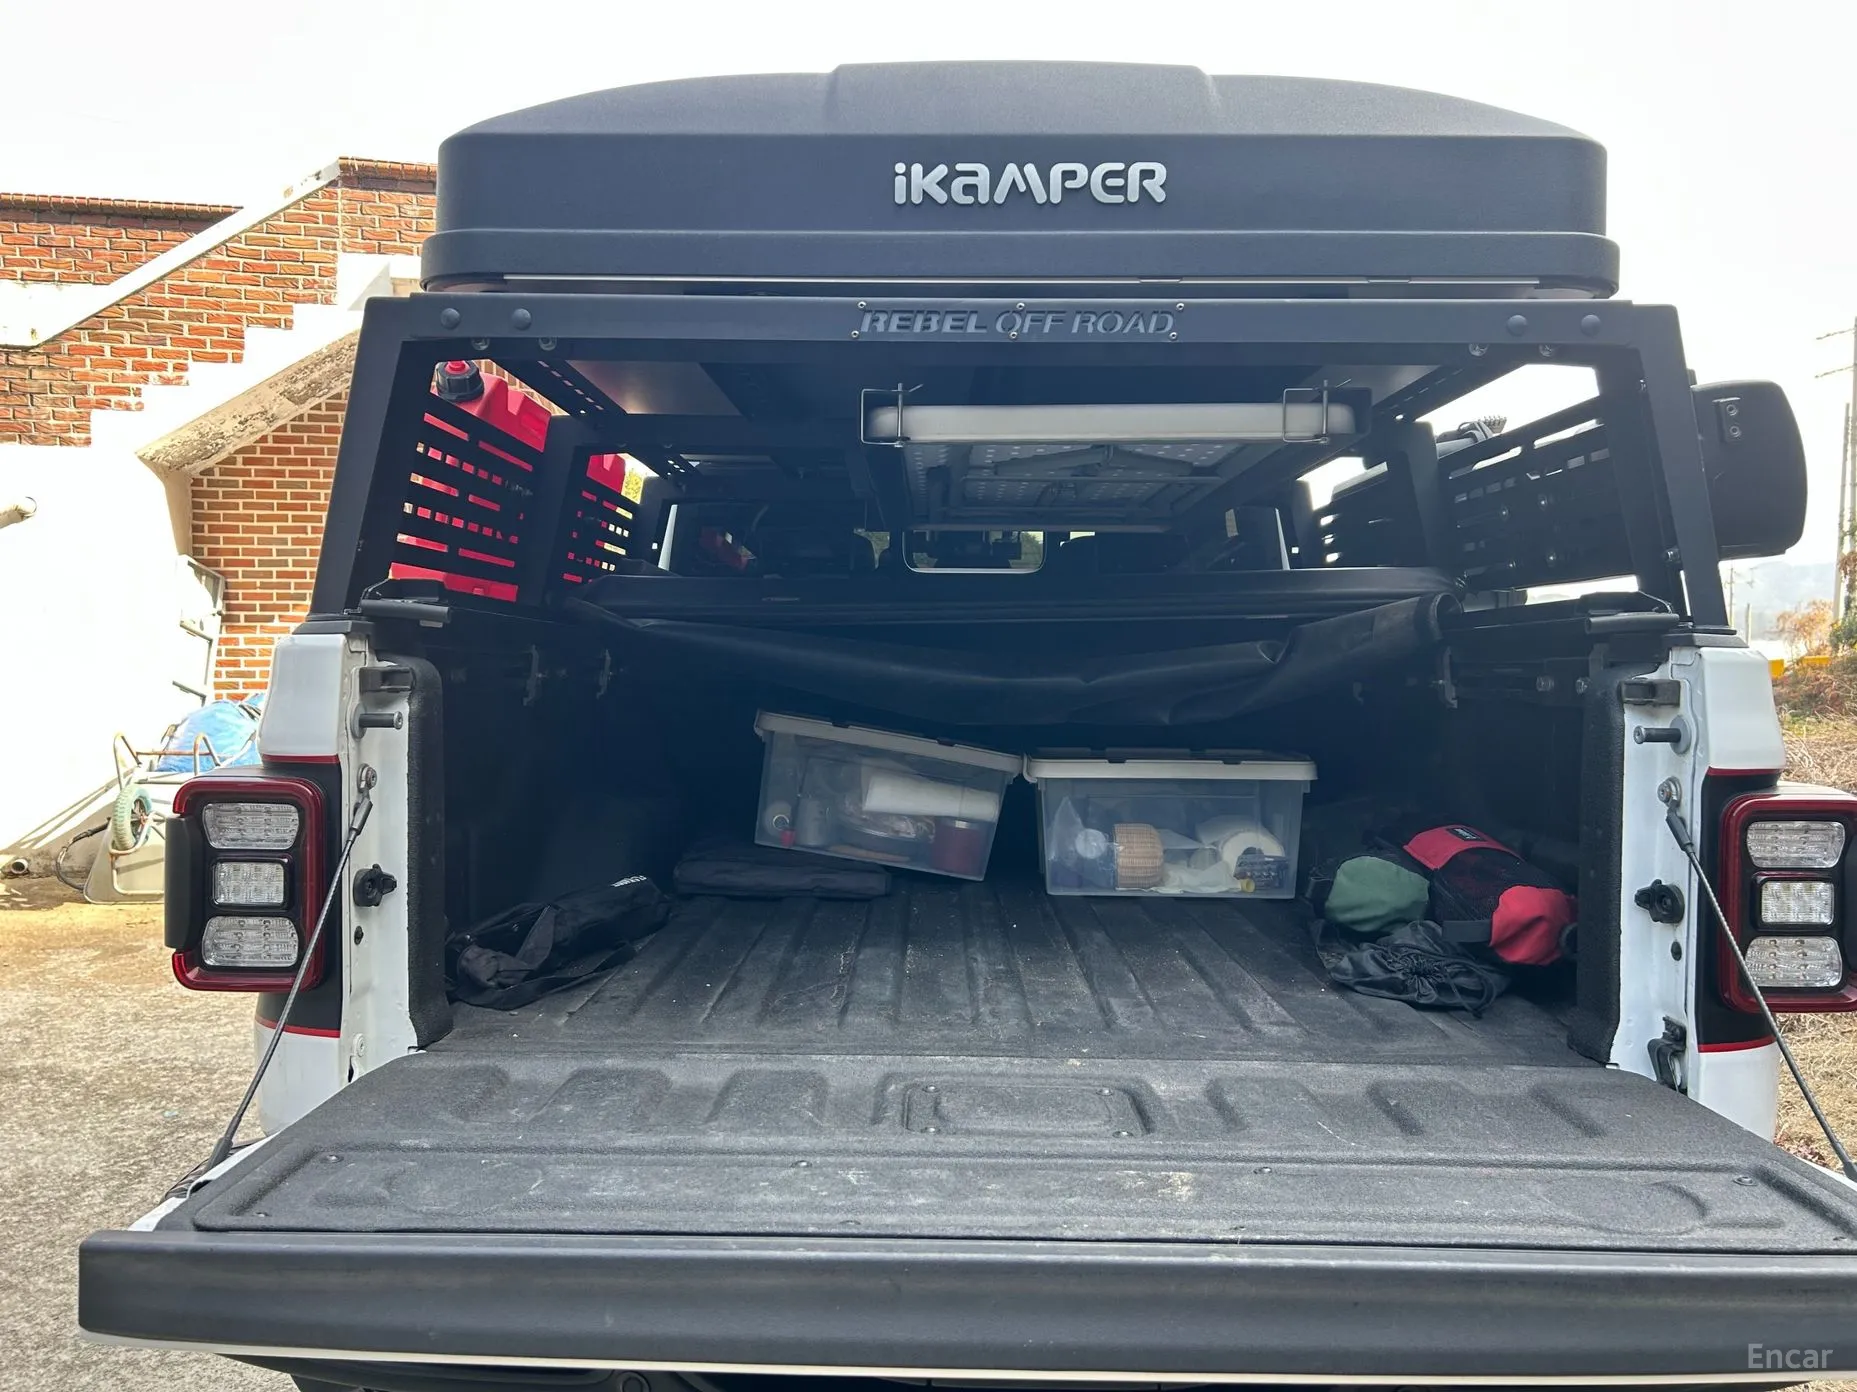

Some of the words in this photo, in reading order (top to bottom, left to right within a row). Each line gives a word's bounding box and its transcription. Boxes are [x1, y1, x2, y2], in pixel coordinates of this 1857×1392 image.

[860, 309, 988, 333] REBEL
[995, 309, 1067, 334] OFF
[1071, 310, 1175, 334] ROAD
